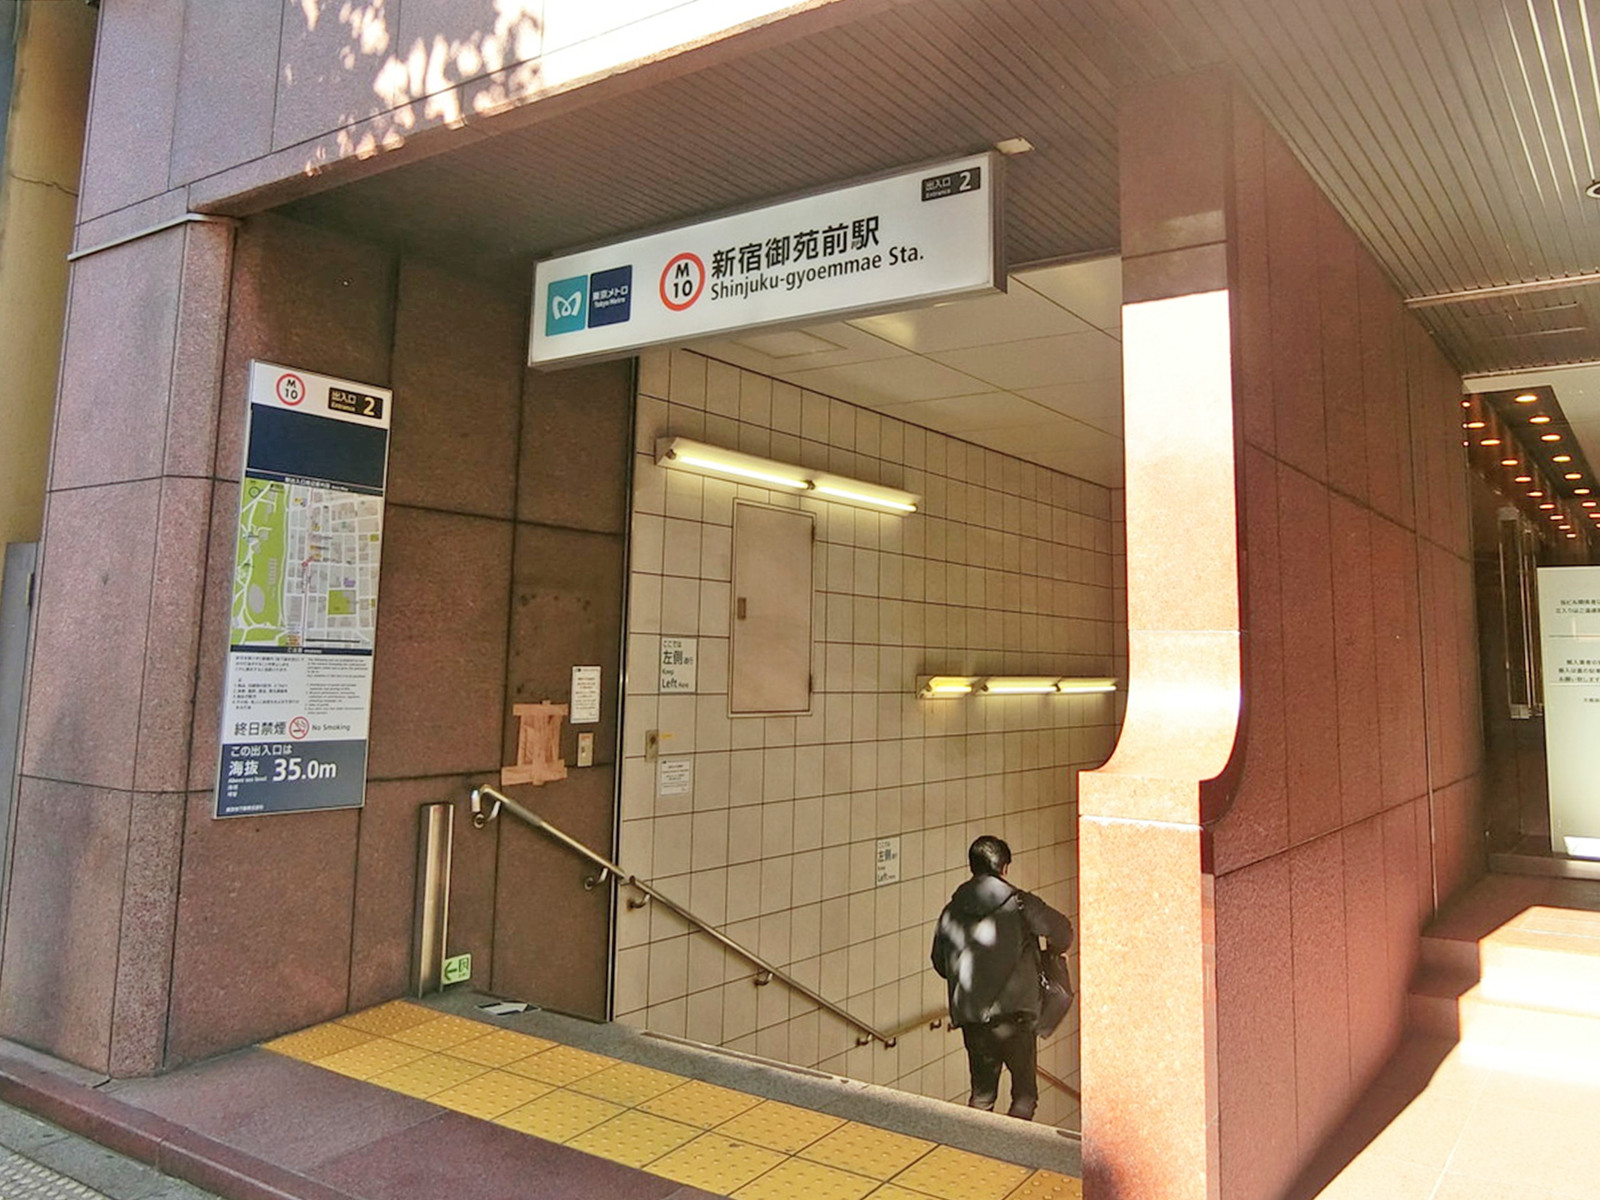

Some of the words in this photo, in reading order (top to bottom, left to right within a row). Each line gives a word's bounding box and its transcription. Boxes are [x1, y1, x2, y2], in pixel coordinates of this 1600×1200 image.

[926, 177, 951, 191] 出入口
[959, 171, 972, 191] 2
[711, 216, 879, 280] 新宿御苑前駅
[675, 262, 690, 280] M
[711, 254, 882, 300] Shinjuku-gyoemmae
[889, 246, 924, 266] Sta.
[673, 280, 693, 299] 10
[286, 379, 297, 389] M
[285, 388, 298, 400] 10
[331, 391, 357, 404] 出入口
[363, 397, 376, 416] 2
[662, 678, 677, 688] Left
[234, 721, 287, 736] 終日禁煙
[323, 723, 351, 732] Smoking
[231, 744, 293, 757] この出入口は
[228, 760, 259, 776] 海抜
[272, 758, 337, 782] 35.0m
